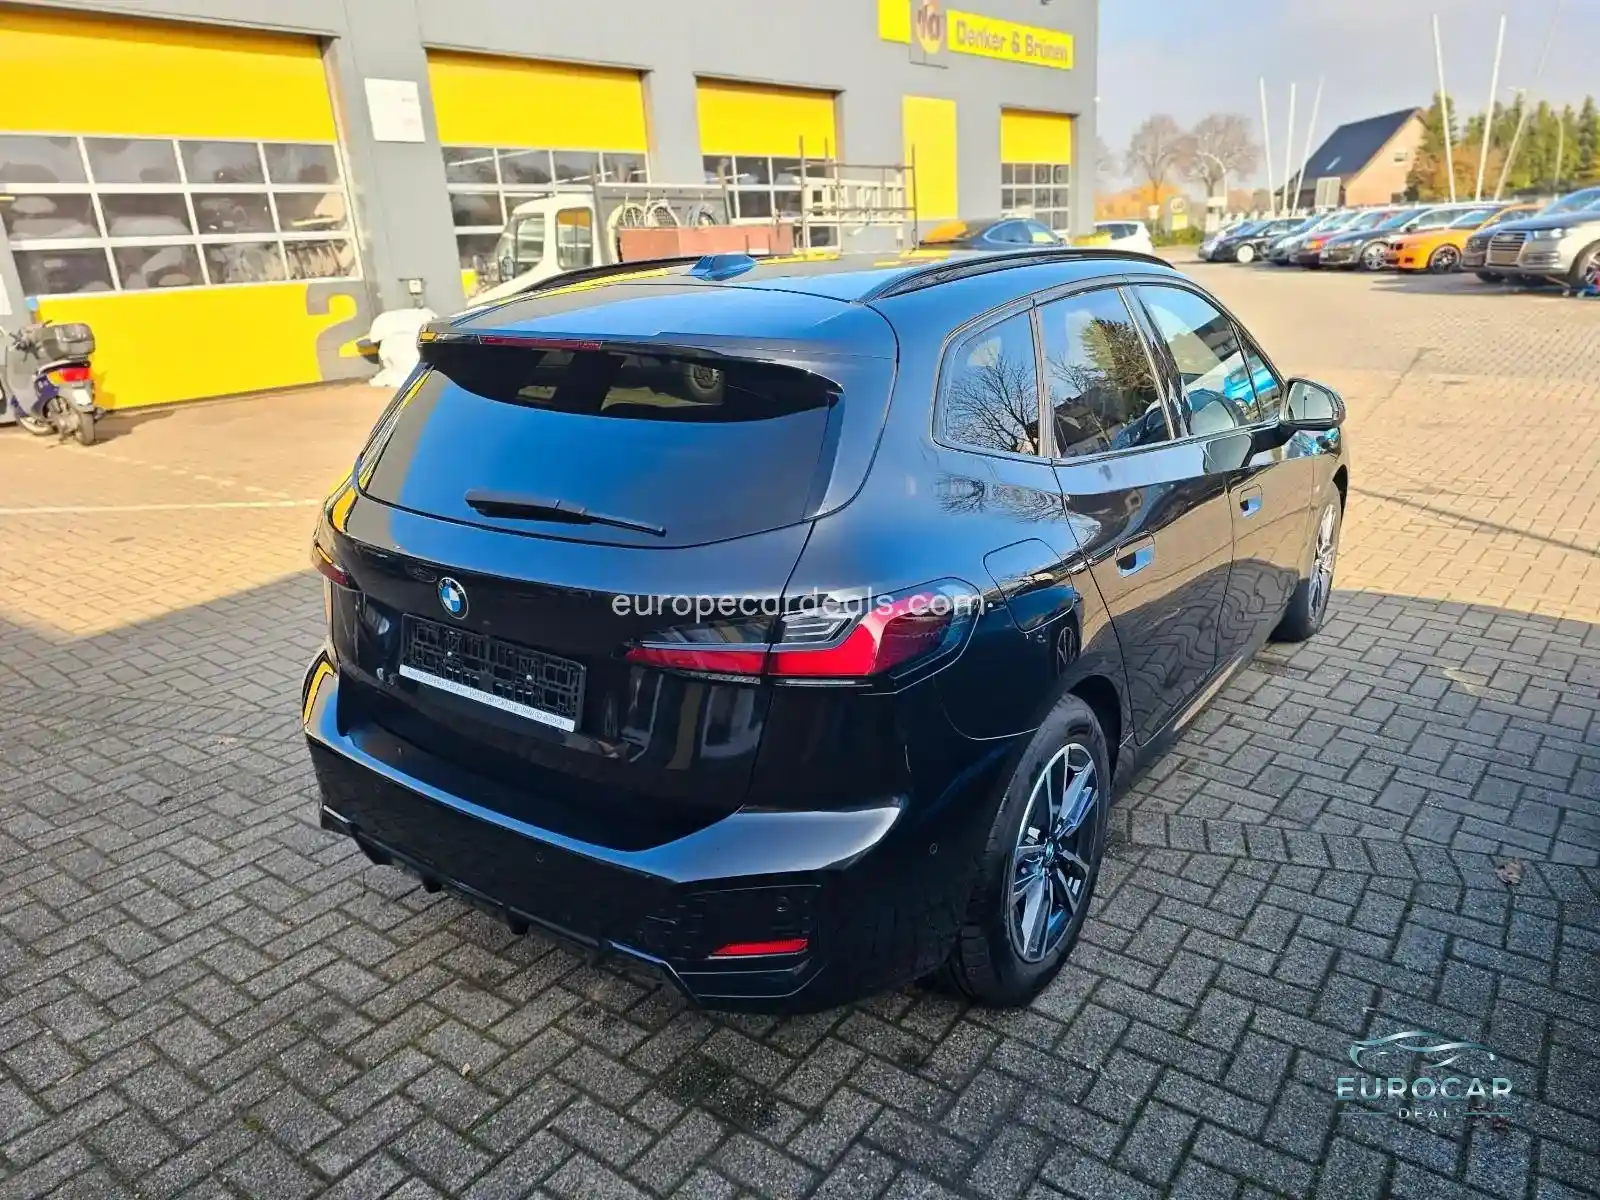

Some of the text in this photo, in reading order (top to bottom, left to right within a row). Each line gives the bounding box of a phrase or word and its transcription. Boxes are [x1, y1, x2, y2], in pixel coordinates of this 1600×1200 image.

[956, 19, 1007, 53] Denker
[1011, 29, 1021, 56] &
[306, 281, 379, 381] 2
